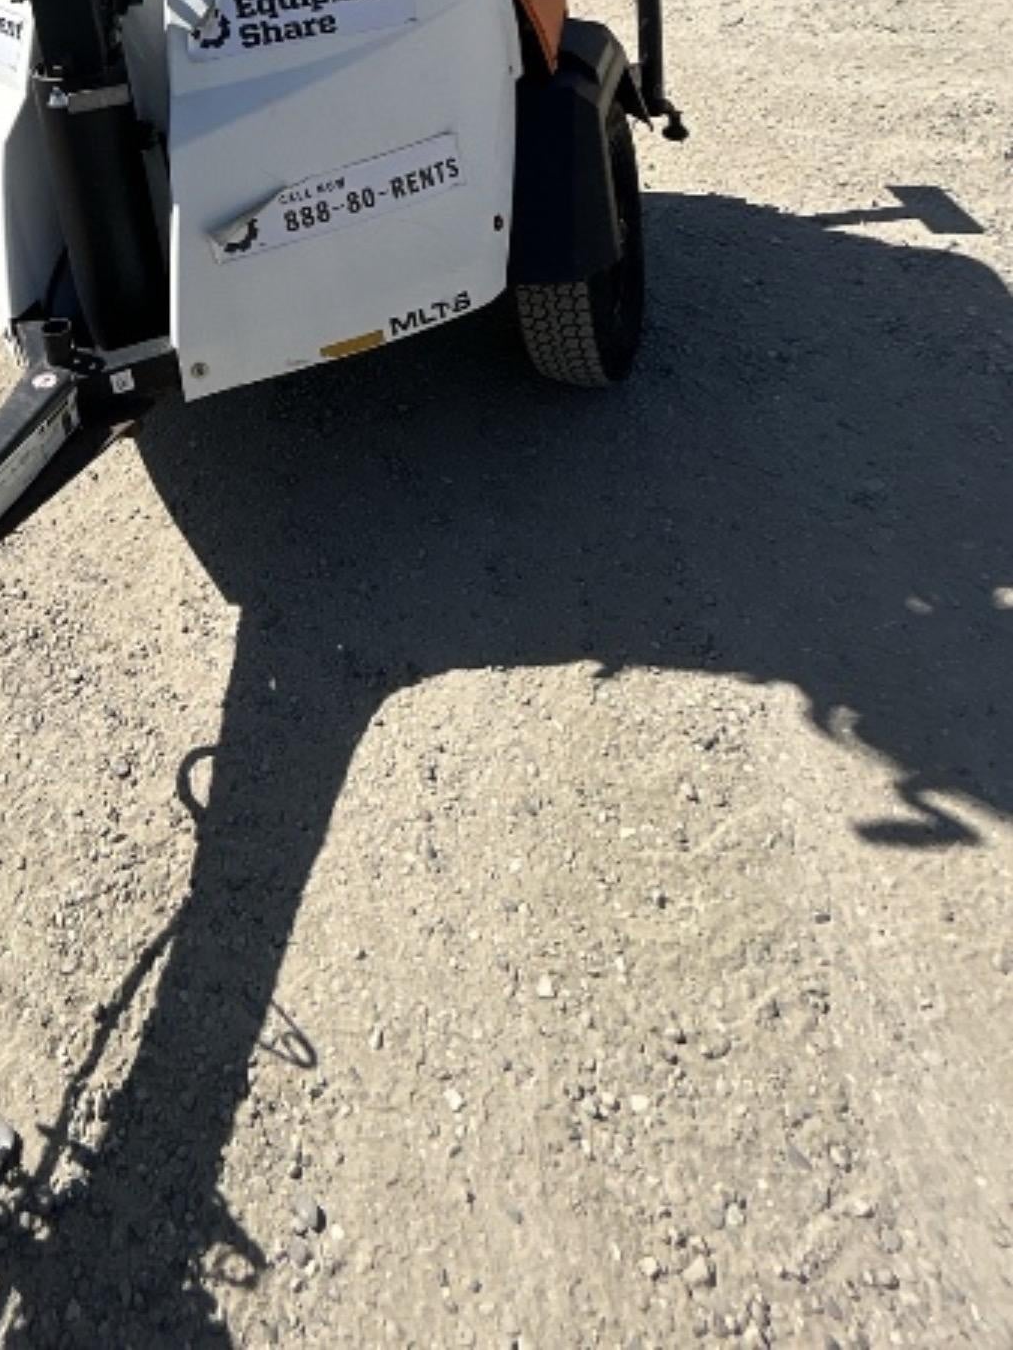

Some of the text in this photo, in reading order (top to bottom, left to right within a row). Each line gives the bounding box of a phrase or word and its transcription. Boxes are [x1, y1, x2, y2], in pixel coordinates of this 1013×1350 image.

[238, 13, 338, 48] Share
[278, 188, 312, 204] CALL
[283, 157, 460, 232] 888-80-RENTS
